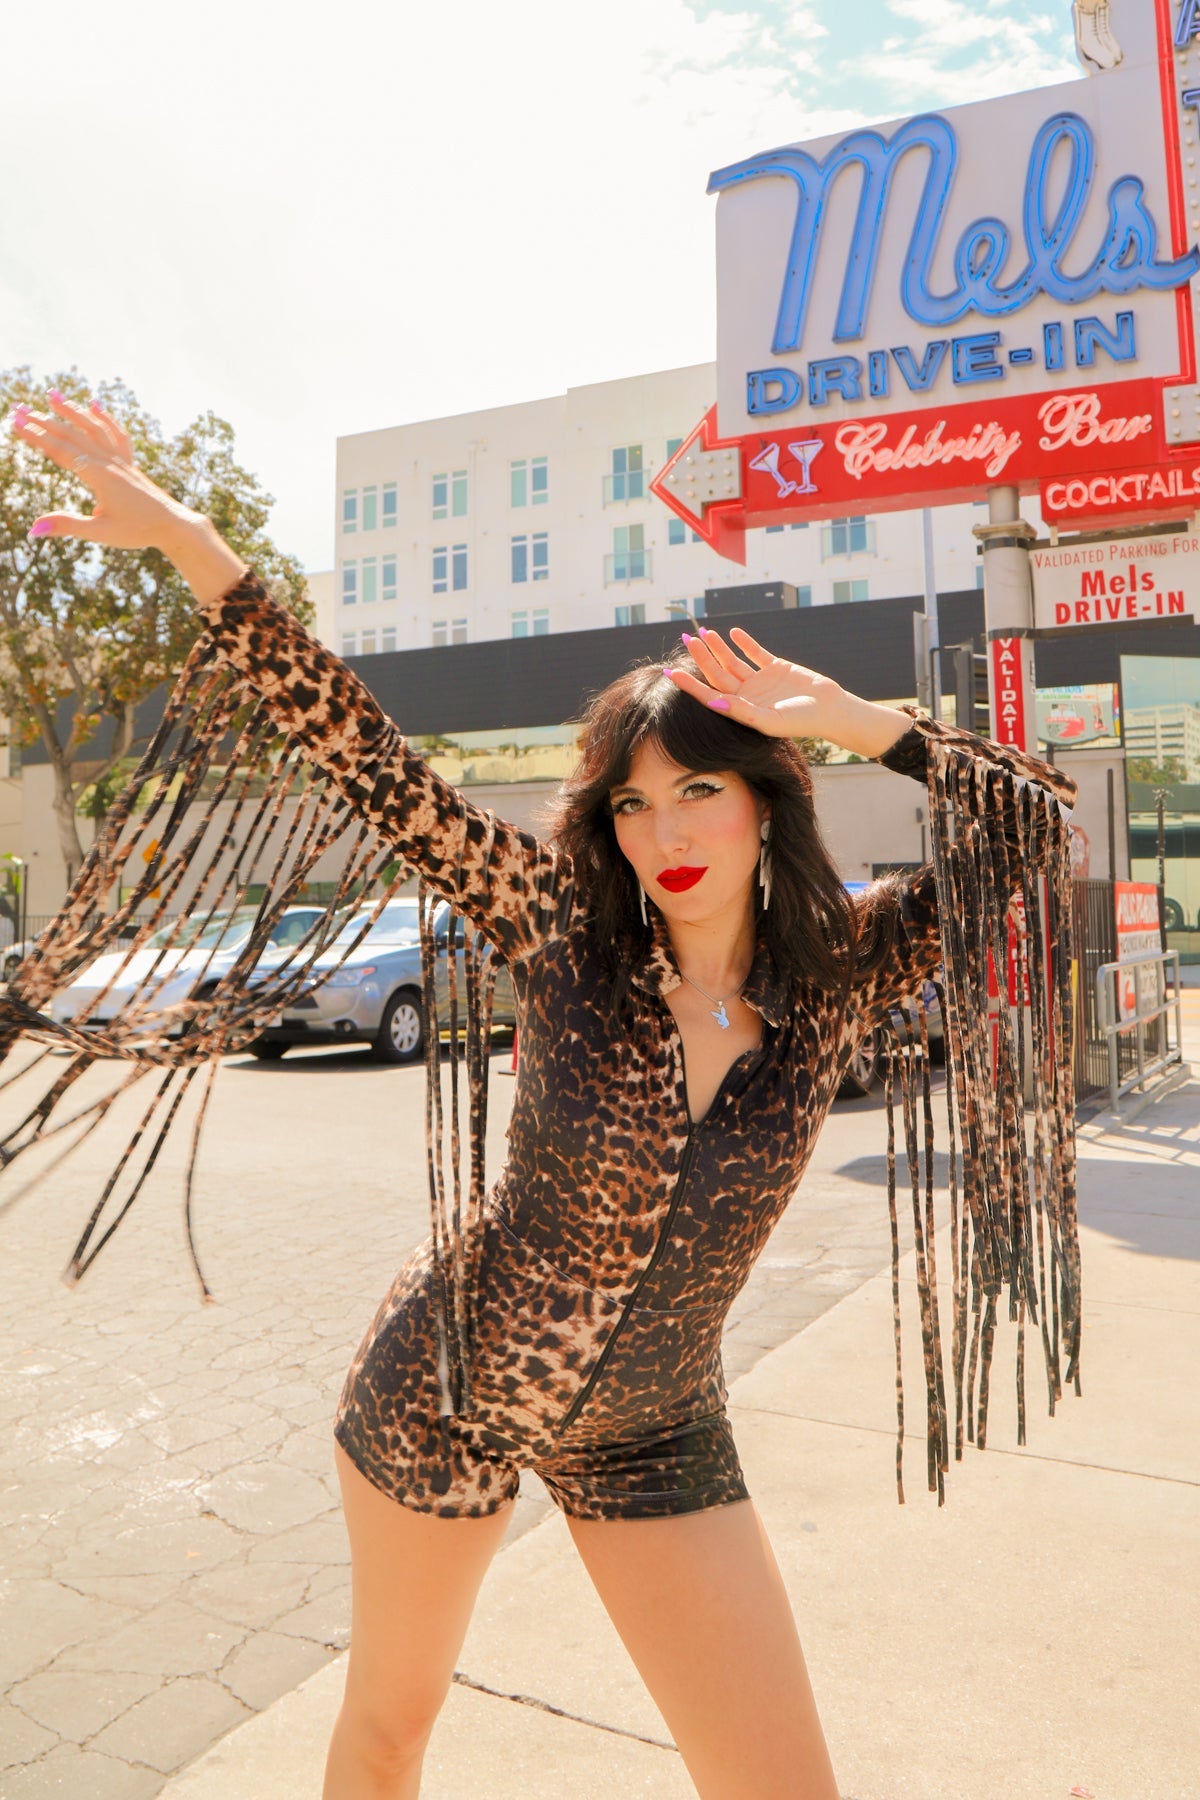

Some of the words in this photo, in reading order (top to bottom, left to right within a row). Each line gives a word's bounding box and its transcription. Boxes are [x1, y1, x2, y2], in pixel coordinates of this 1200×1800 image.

[706, 112, 1200, 355] Mels
[746, 311, 1135, 417] DRIVE-IN
[835, 420, 1022, 479] Celebrity
[1038, 393, 1153, 452] Bar
[1055, 591, 1185, 624] DRIVE-IN
[1081, 564, 1155, 597] Mels
